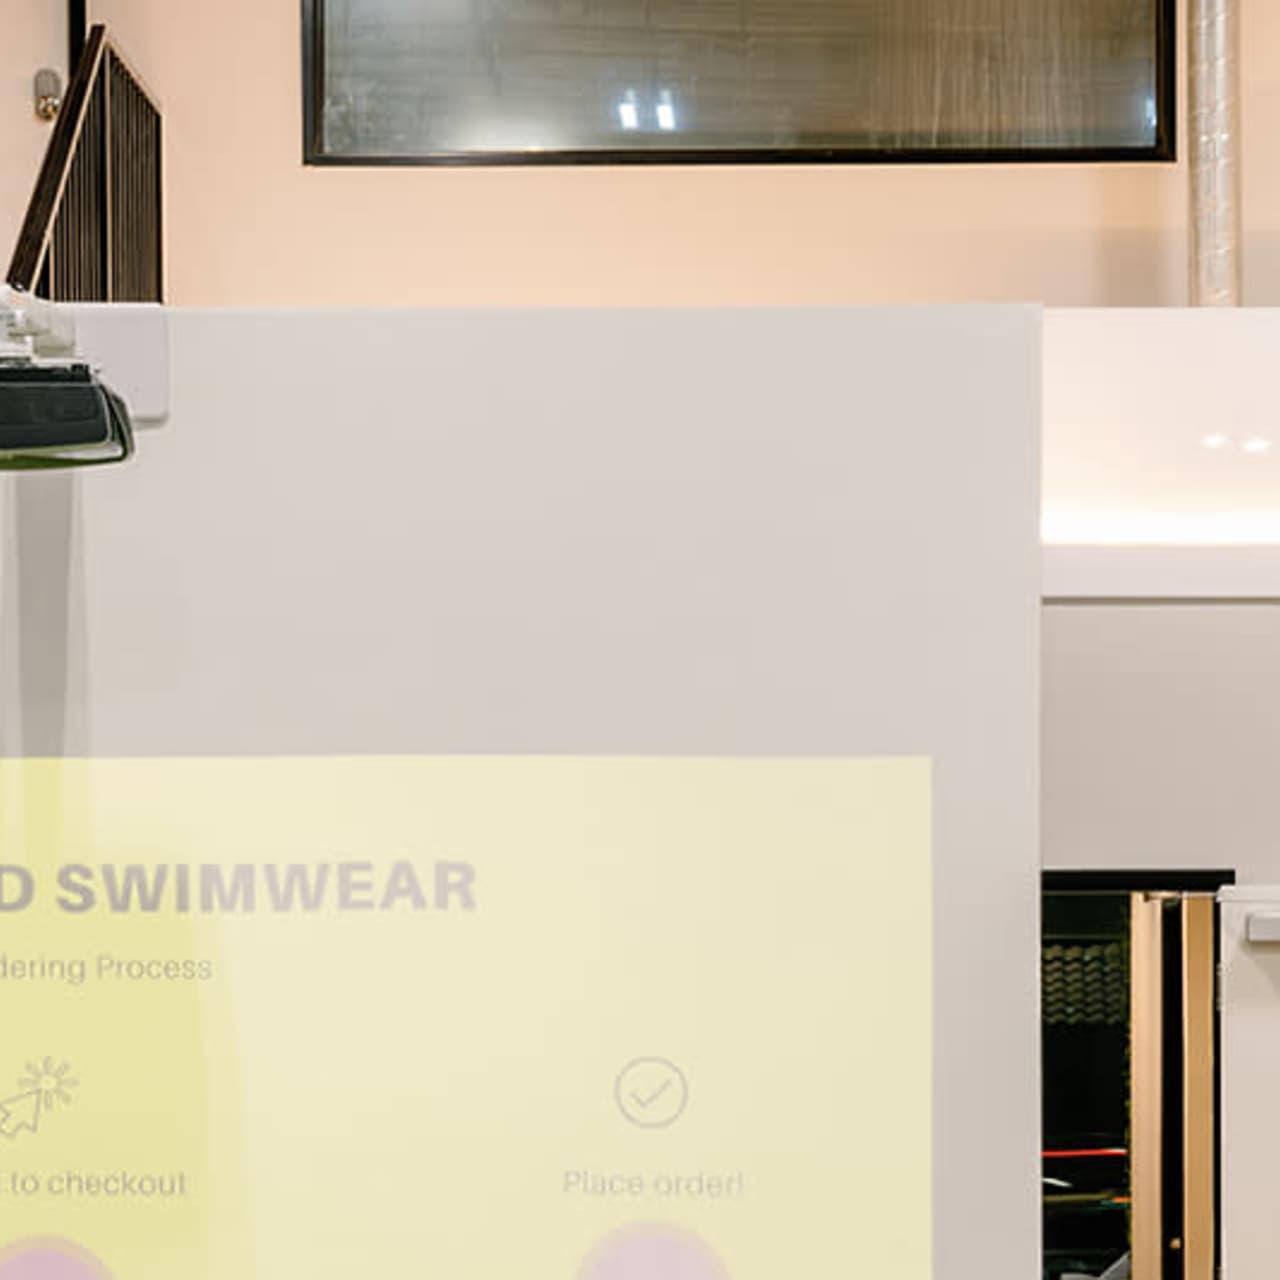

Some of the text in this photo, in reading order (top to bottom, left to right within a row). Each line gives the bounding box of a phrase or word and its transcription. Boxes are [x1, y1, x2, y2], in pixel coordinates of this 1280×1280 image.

[54, 859, 477, 914] SWIMWEAR
[96, 954, 214, 982] Process
[10, 1170, 40, 1196] to
[47, 1169, 187, 1196] checkout
[562, 1169, 643, 1196] Place
